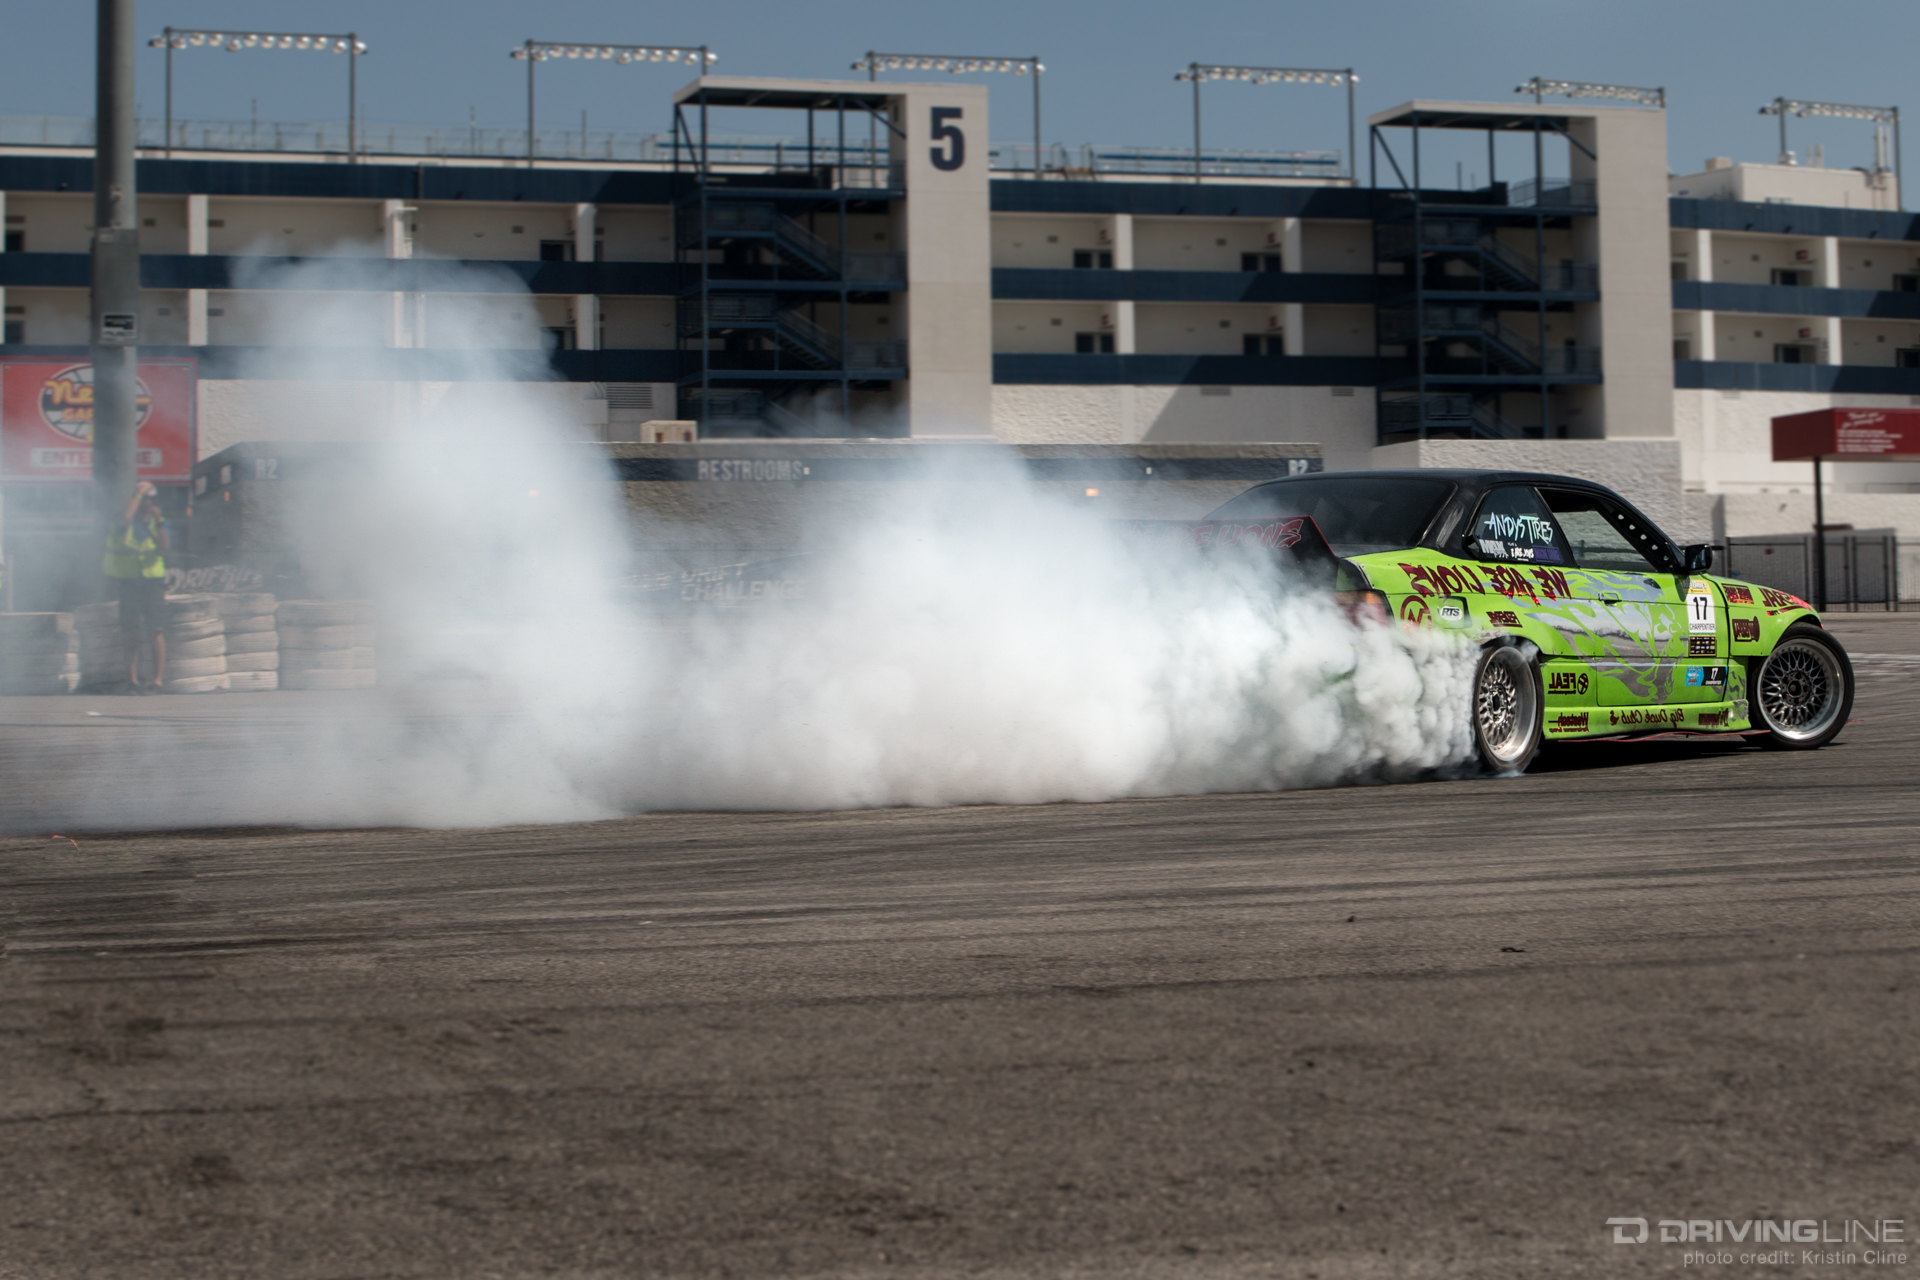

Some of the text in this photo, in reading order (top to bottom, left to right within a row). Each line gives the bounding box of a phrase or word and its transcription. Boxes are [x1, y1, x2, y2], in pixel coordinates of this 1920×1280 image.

[929, 106, 965, 172] 5
[255, 458, 278, 480] R2
[697, 459, 803, 481] RESTROOMS
[1288, 459, 1309, 475] R2
[1160, 523, 1213, 549] ARE
[1216, 518, 1304, 549] LIONS
[680, 580, 805, 601] CHALLENGE
[1441, 606, 1461, 617] RTS
[1692, 596, 1708, 621] 17
[1689, 623, 1716, 631] CHARPENTIER
[1710, 667, 1719, 681] 17
